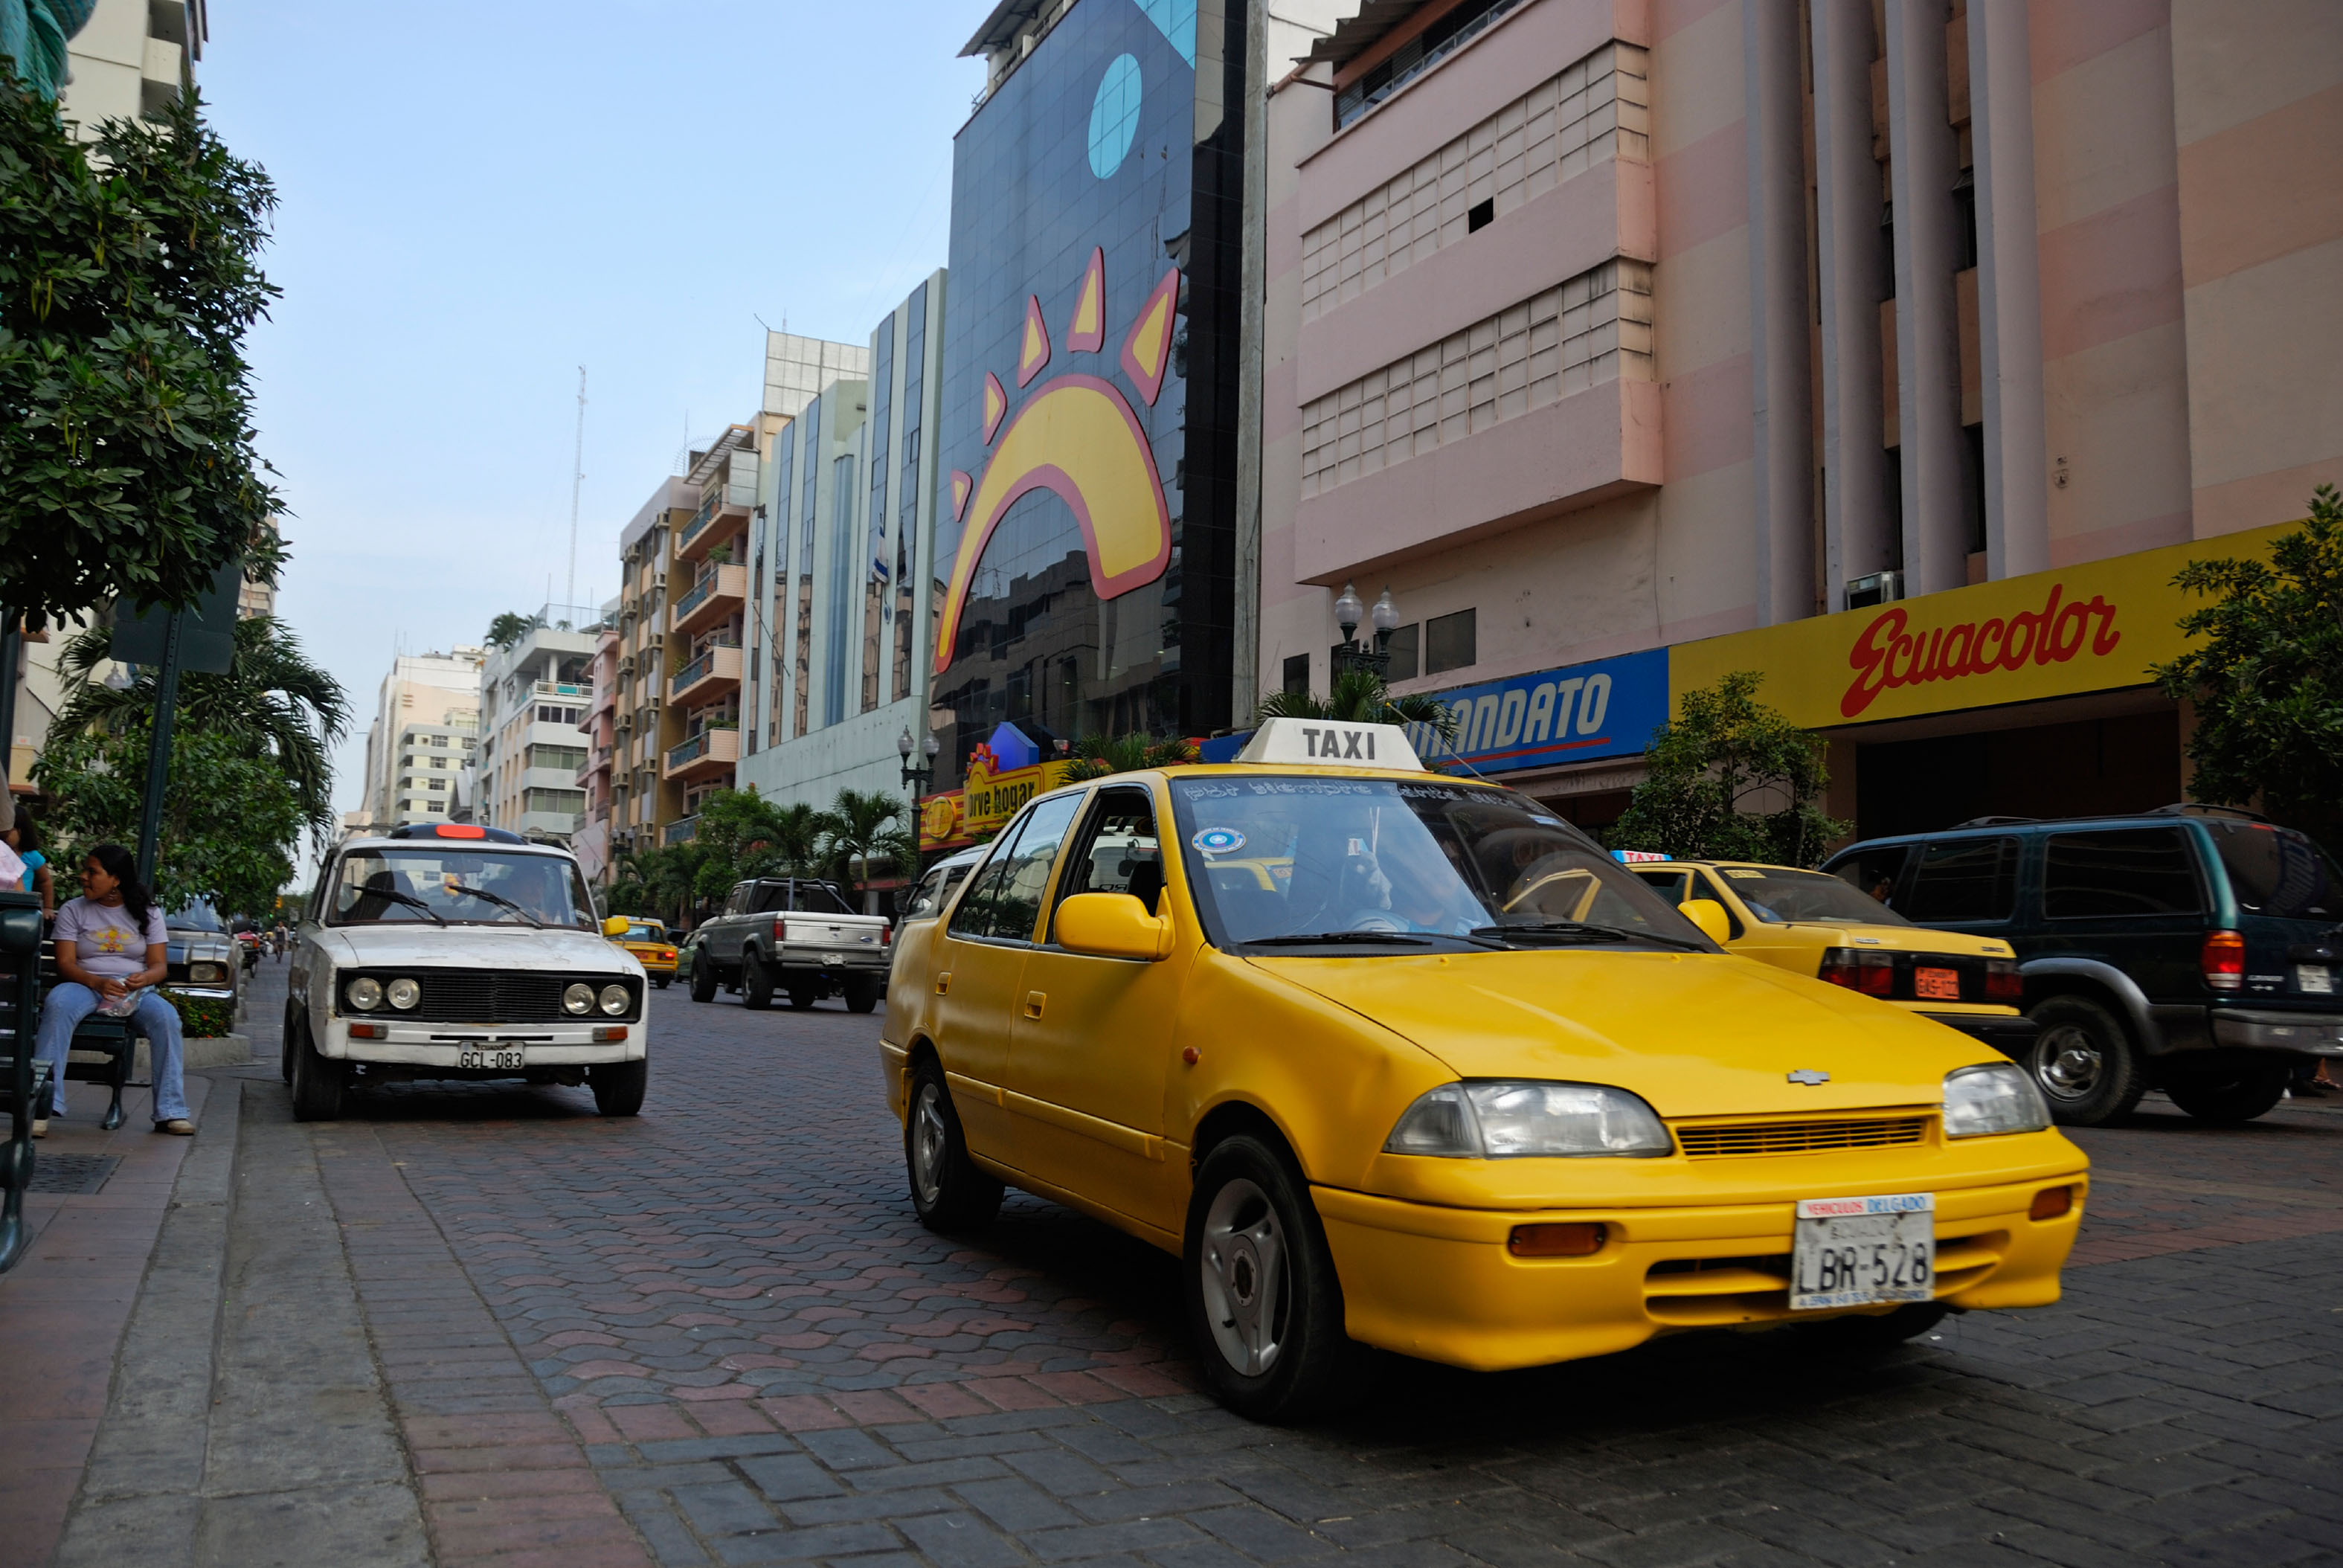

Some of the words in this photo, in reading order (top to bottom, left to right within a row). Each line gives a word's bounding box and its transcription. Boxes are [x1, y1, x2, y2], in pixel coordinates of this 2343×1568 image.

[1840, 583, 2121, 718] Ecuacolor
[1400, 672, 1613, 758] MANDATO
[1302, 728, 1376, 760] TAXI
[968, 791, 991, 818] orve
[994, 781, 1035, 815] hogar
[1626, 852, 1662, 862] TAXI
[460, 1052, 522, 1068] GCL-083
[1867, 1196, 1926, 1213] DELGADO
[1798, 1242, 1928, 1294] LBR-528
